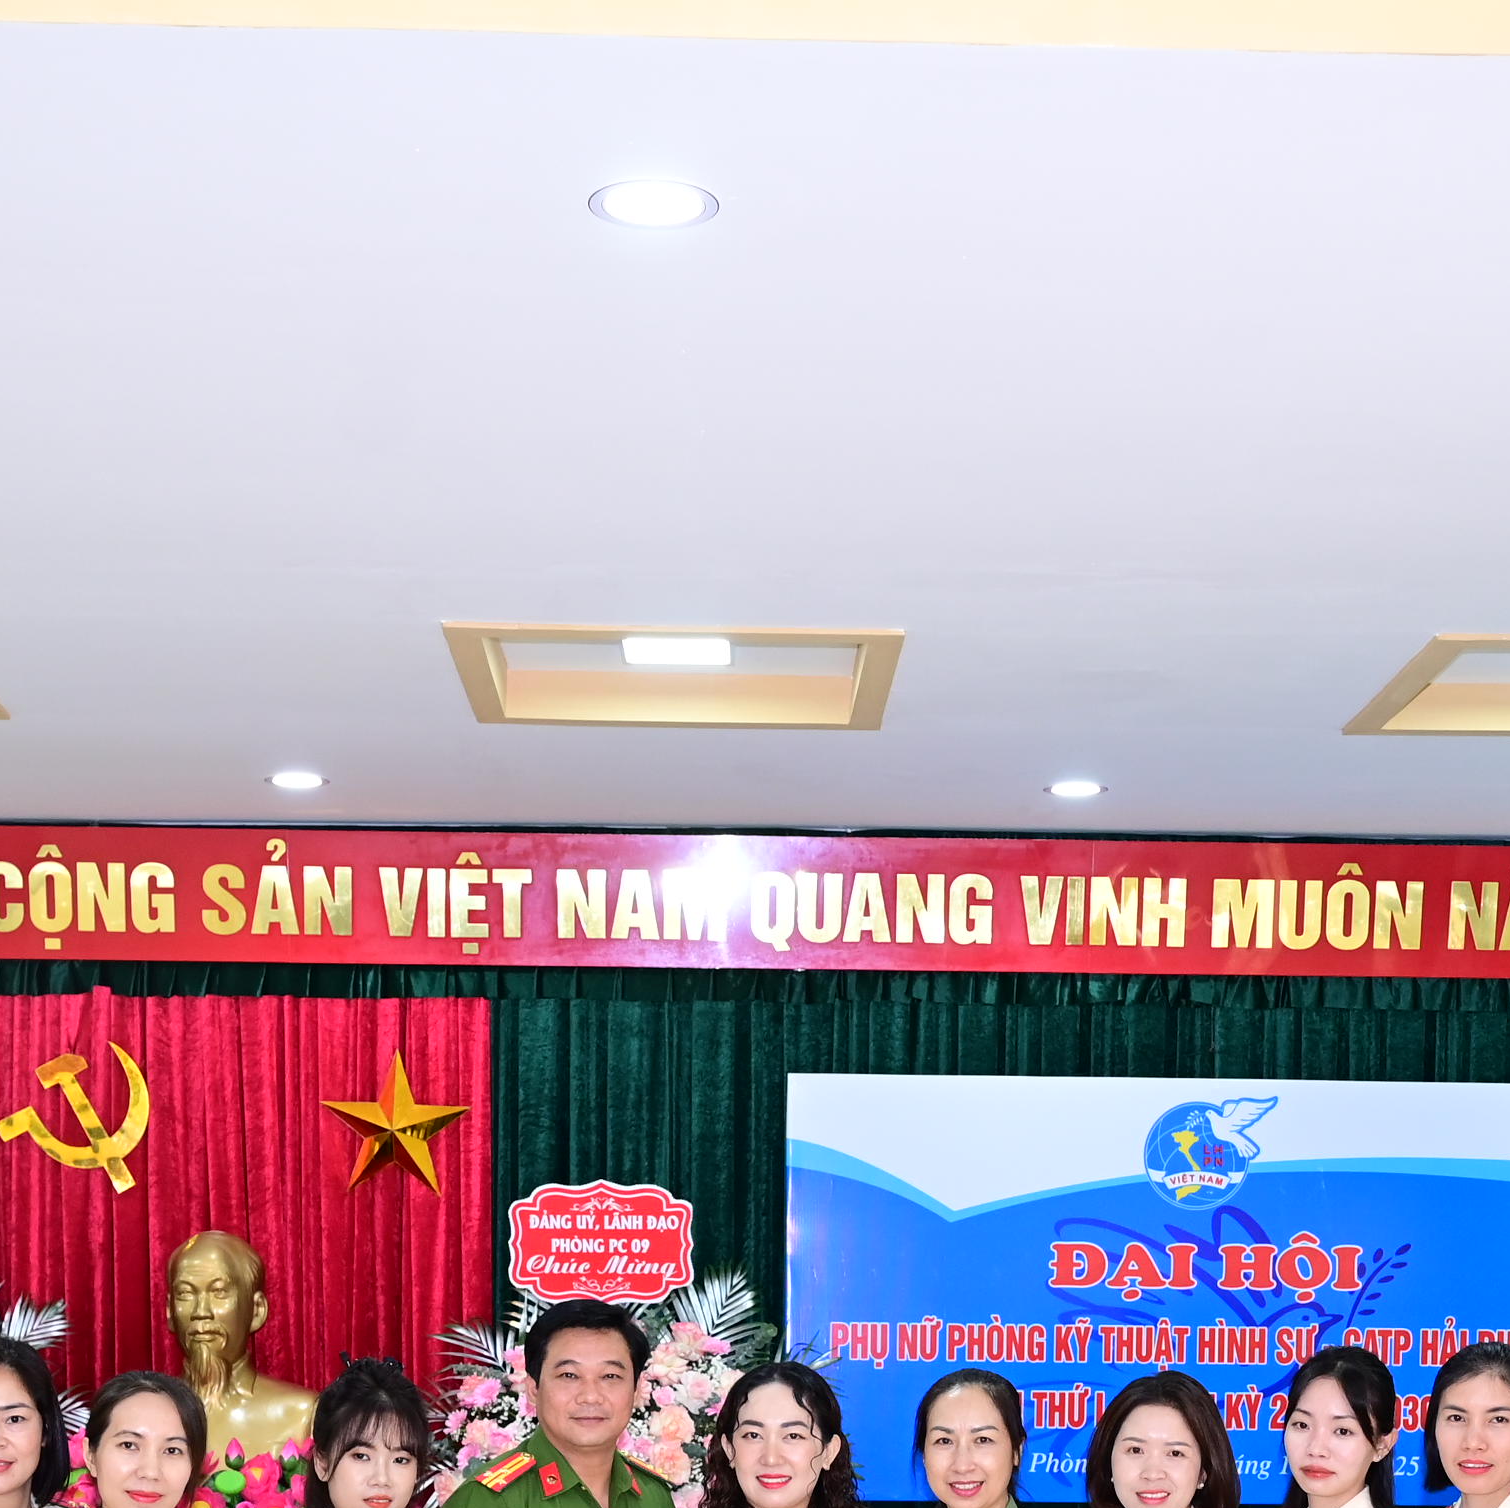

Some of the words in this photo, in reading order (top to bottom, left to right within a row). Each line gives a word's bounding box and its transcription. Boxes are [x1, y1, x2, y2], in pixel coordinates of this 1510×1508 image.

[201, 838, 353, 937] SẢN
[378, 851, 533, 955] VIỆT
[555, 868, 729, 942] NAM
[749, 871, 994, 952] QUANG
[1019, 875, 1187, 948] VINH
[1211, 863, 1422, 951] MUÔN
[1199, 1175, 1223, 1185] NAM
[529, 1210, 572, 1230] ĐẢNG
[603, 1212, 643, 1230] LÃNH
[646, 1215, 679, 1233] ĐẠO
[551, 1235, 605, 1254] PHÒNG
[609, 1239, 628, 1253] PC
[631, 1239, 651, 1253] 09
[526, 1254, 591, 1275] Chúc
[597, 1255, 678, 1279] Mừng
[1049, 1242, 1197, 1302] ĐẠI
[1217, 1231, 1362, 1303] HỘI
[830, 1322, 889, 1368] PHỤ
[897, 1315, 942, 1361] NỮ
[946, 1314, 1047, 1363] PHÒNG
[1054, 1318, 1092, 1364] KỸ
[1099, 1318, 1191, 1371] THUẬT
[1196, 1319, 1268, 1366] HÌNH
[1031, 1383, 1091, 1429] THỨ
[1224, 1384, 1264, 1431] KỲ
[1029, 1452, 1088, 1473] Phòn
